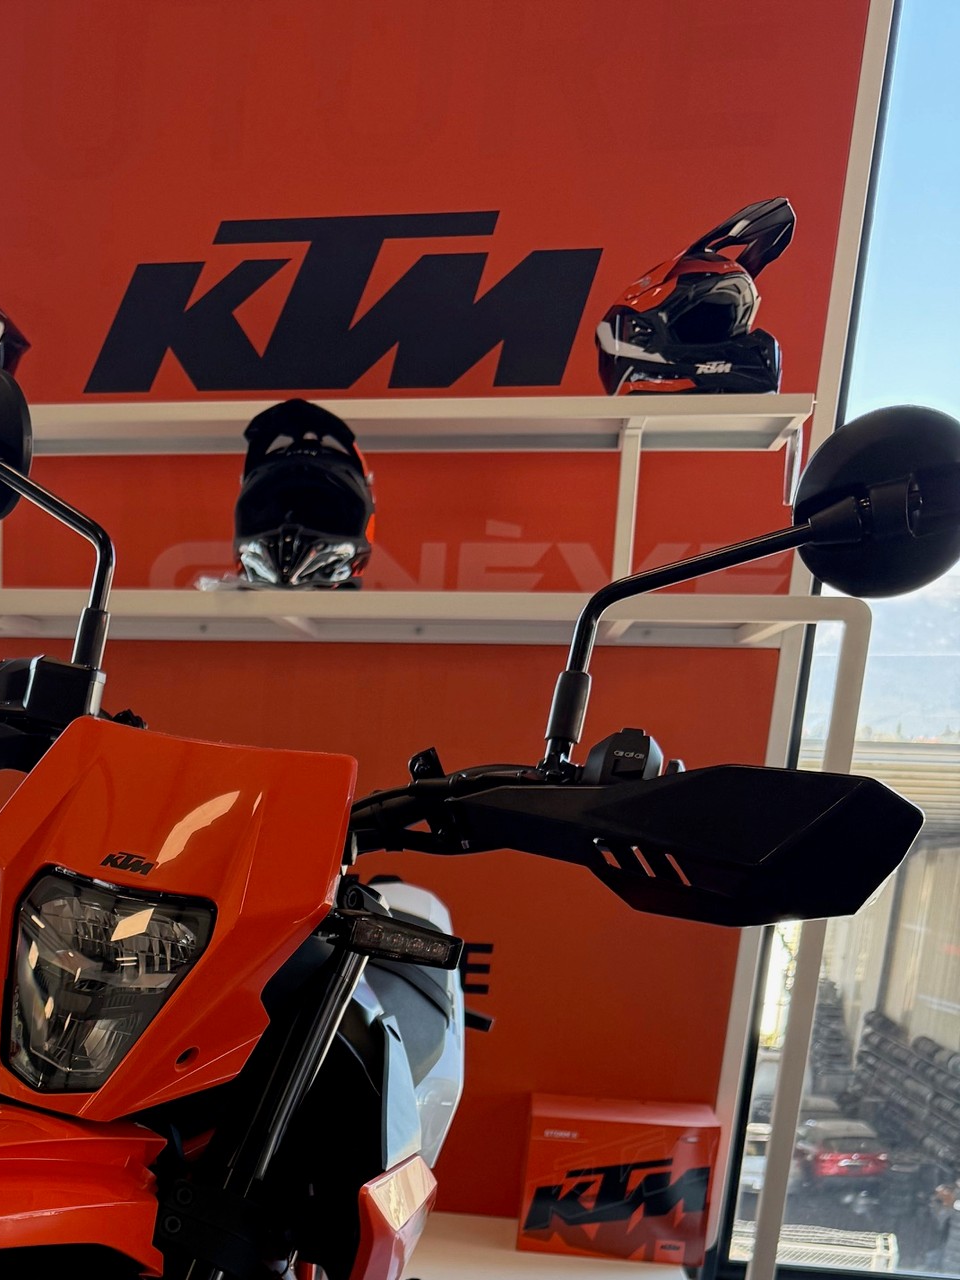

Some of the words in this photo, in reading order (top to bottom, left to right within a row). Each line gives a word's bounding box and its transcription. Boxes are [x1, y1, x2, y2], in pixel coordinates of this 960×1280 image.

[84, 210, 604, 393] KTM
[695, 360, 733, 374] KTM
[100, 851, 155, 876] KTM
[522, 1158, 711, 1231] KTM
